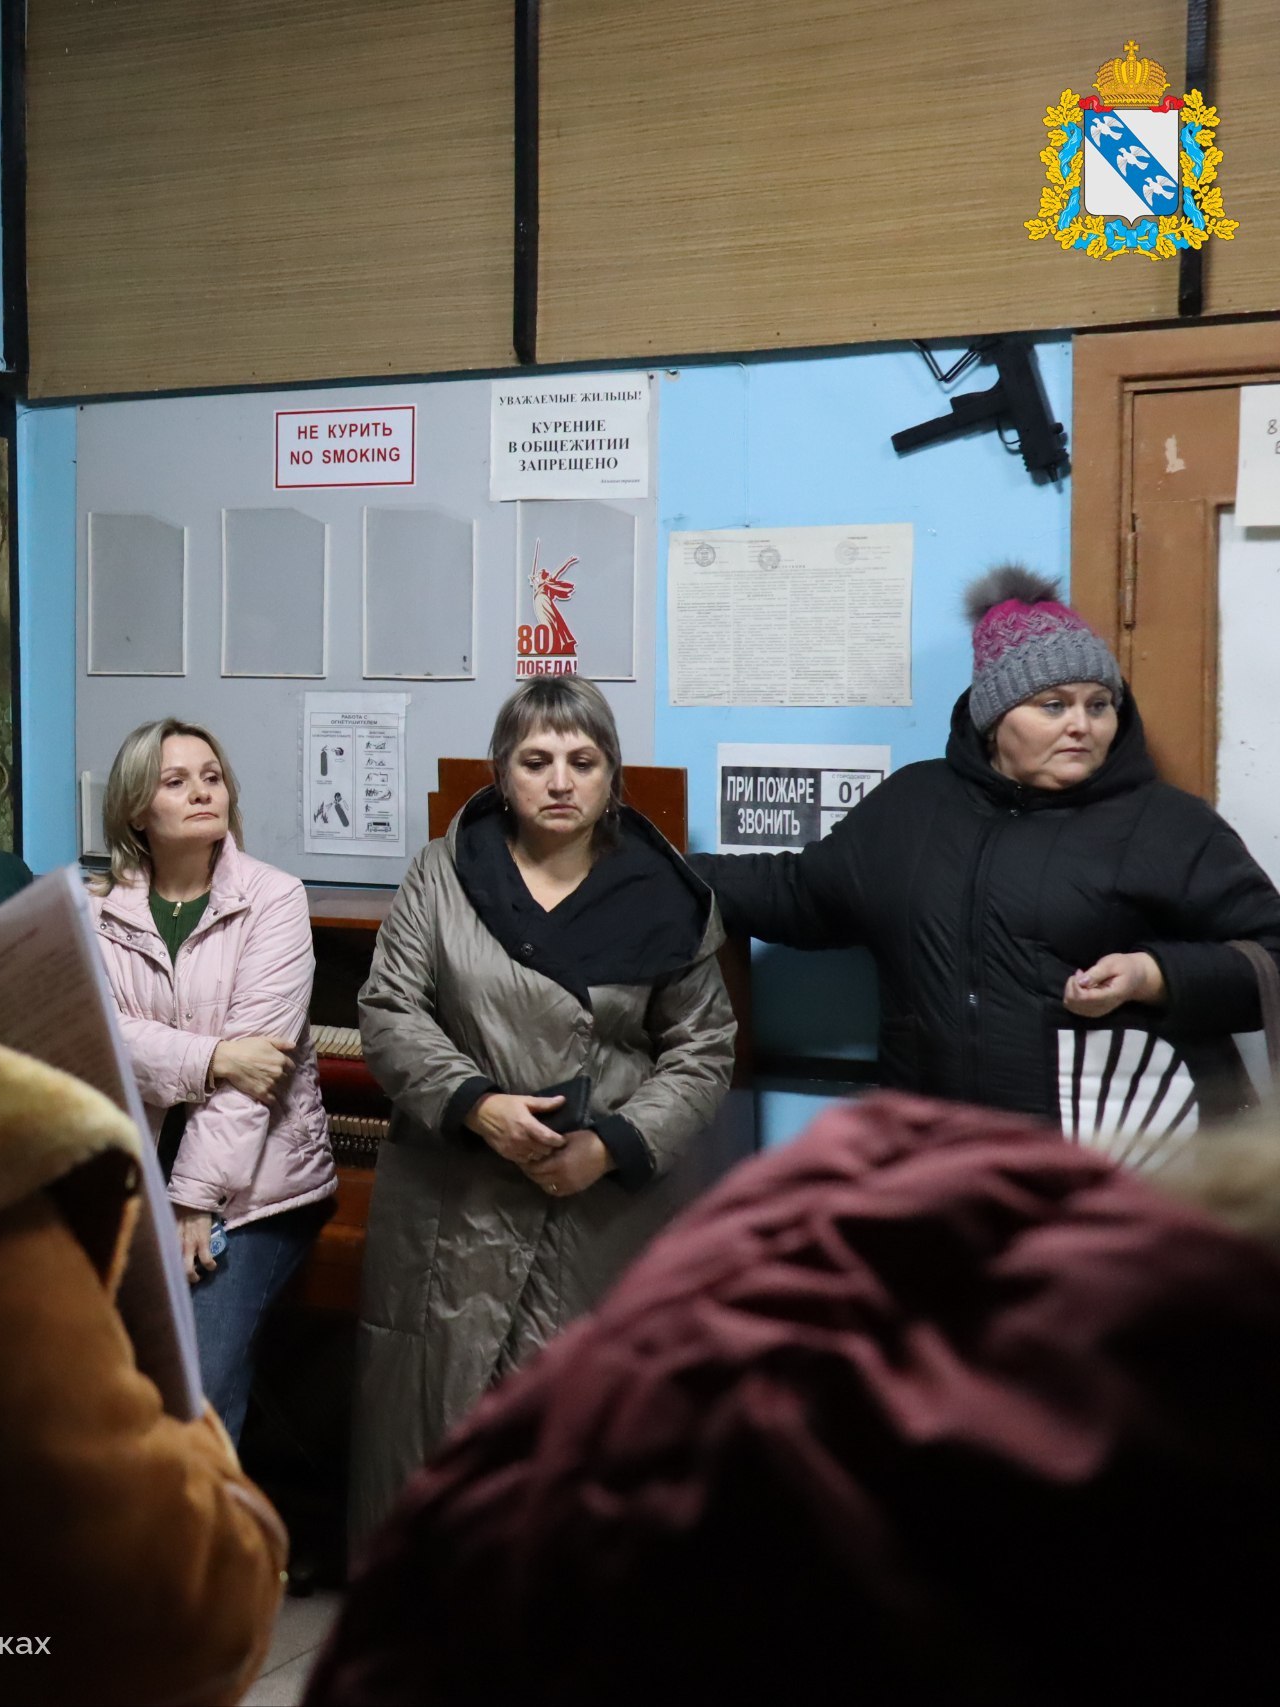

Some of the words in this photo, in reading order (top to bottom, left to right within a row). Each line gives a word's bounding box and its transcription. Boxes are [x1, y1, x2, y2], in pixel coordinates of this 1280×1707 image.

[499, 393, 578, 406] УВАЖАЕМЫЕ
[580, 390, 642, 403] ЖИЛЬЦЫ!
[297, 425, 319, 440] НЕ
[328, 422, 393, 439] КУРИТЬ
[531, 419, 606, 434] КУРЕНИЕ
[508, 441, 517, 453] В
[521, 437, 630, 453] ОБЩЕЖИТИИ
[290, 450, 313, 465] NO
[322, 447, 401, 464] SMOKING
[519, 457, 619, 472] ЗАПРЕЩЕНО
[517, 624, 550, 654] 80
[516, 660, 577, 676] ПОБЕДА!
[726, 775, 754, 803] ПРИ
[757, 776, 815, 804] ПОЖАРЕ
[839, 781, 864, 803] 01
[737, 808, 801, 836] ЗВОНИТЬ
